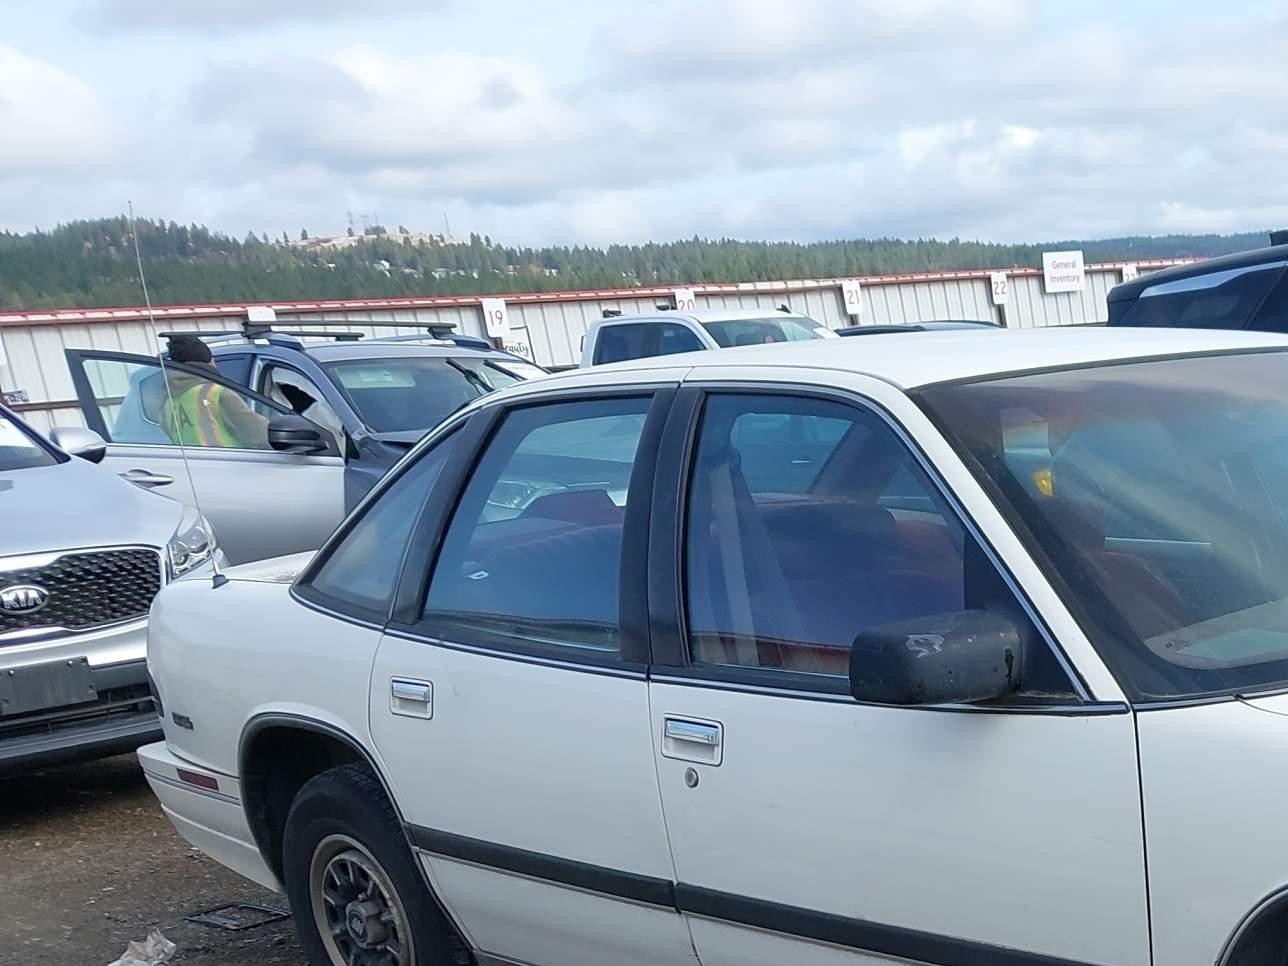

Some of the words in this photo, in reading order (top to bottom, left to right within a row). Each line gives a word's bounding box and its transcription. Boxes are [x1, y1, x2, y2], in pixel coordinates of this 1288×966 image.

[1051, 259, 1077, 270] General
[1050, 273, 1080, 285] Inventory
[993, 280, 1008, 296] 22
[678, 298, 695, 311] 20
[846, 289, 861, 305] 21
[488, 309, 504, 327] 19
[1, 589, 43, 609] KIA
